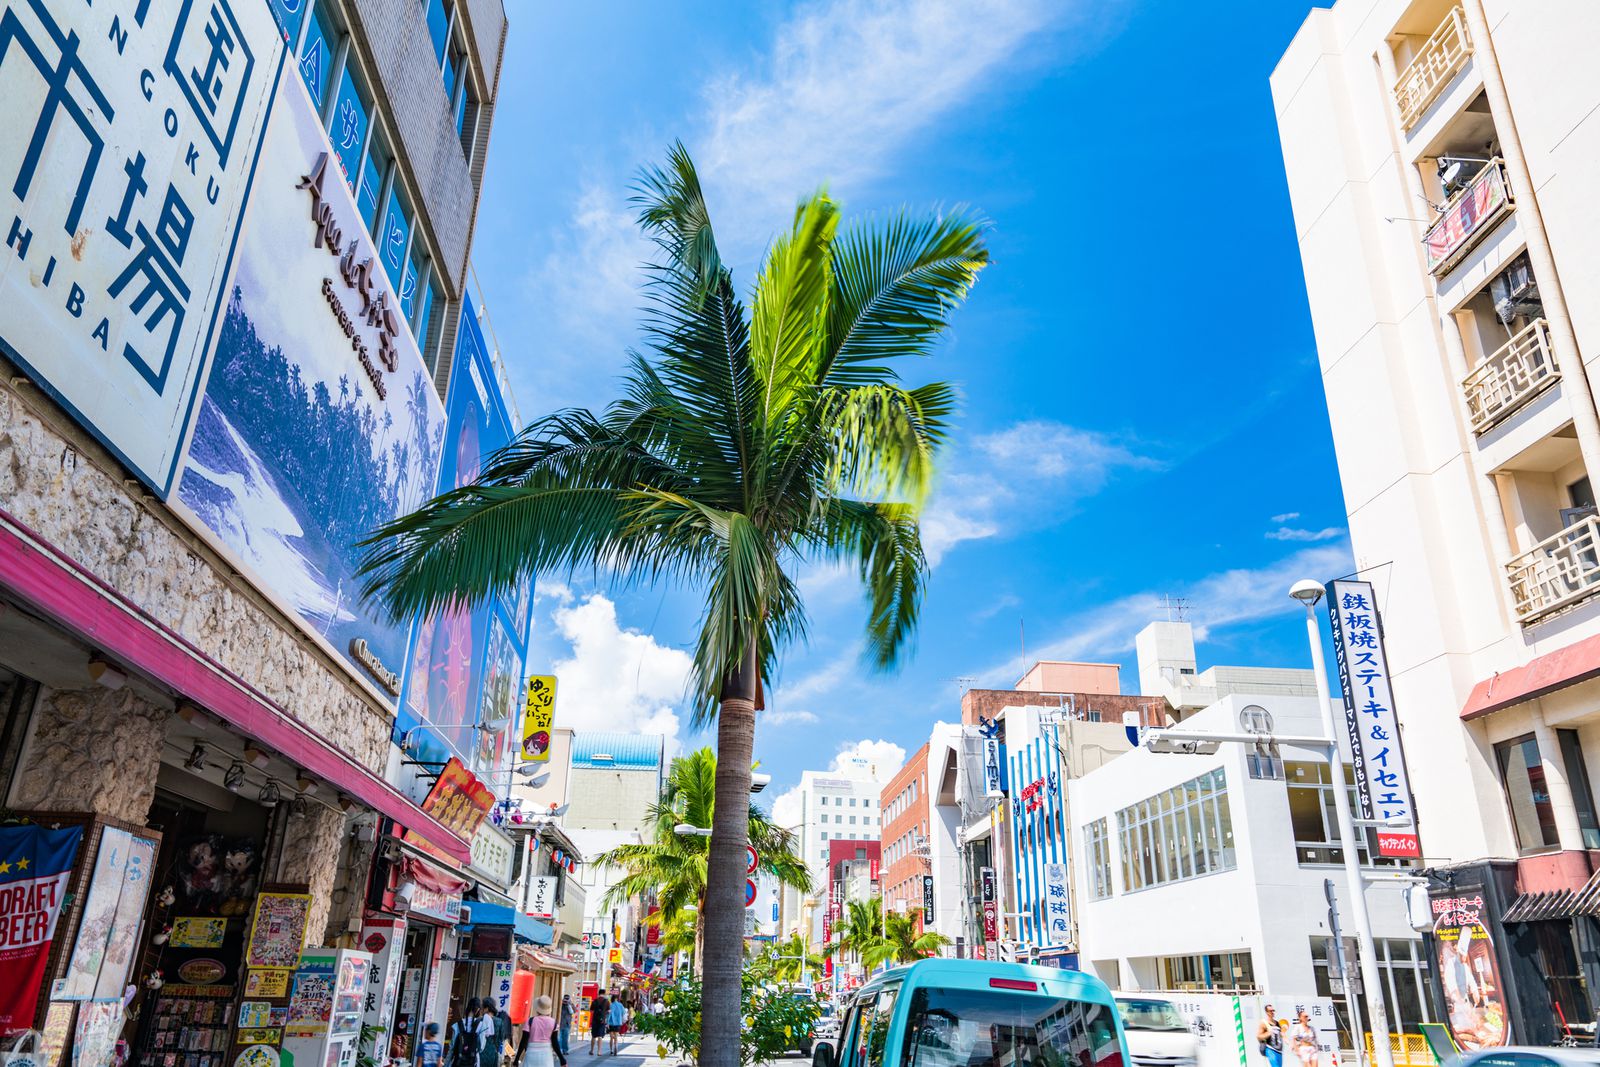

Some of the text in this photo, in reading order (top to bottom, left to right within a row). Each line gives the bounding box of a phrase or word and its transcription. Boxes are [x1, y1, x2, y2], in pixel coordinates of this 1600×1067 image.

[0, 880, 60, 919] DRAFT
[0, 911, 49, 947] BEER
[610, 949, 618, 961] P
